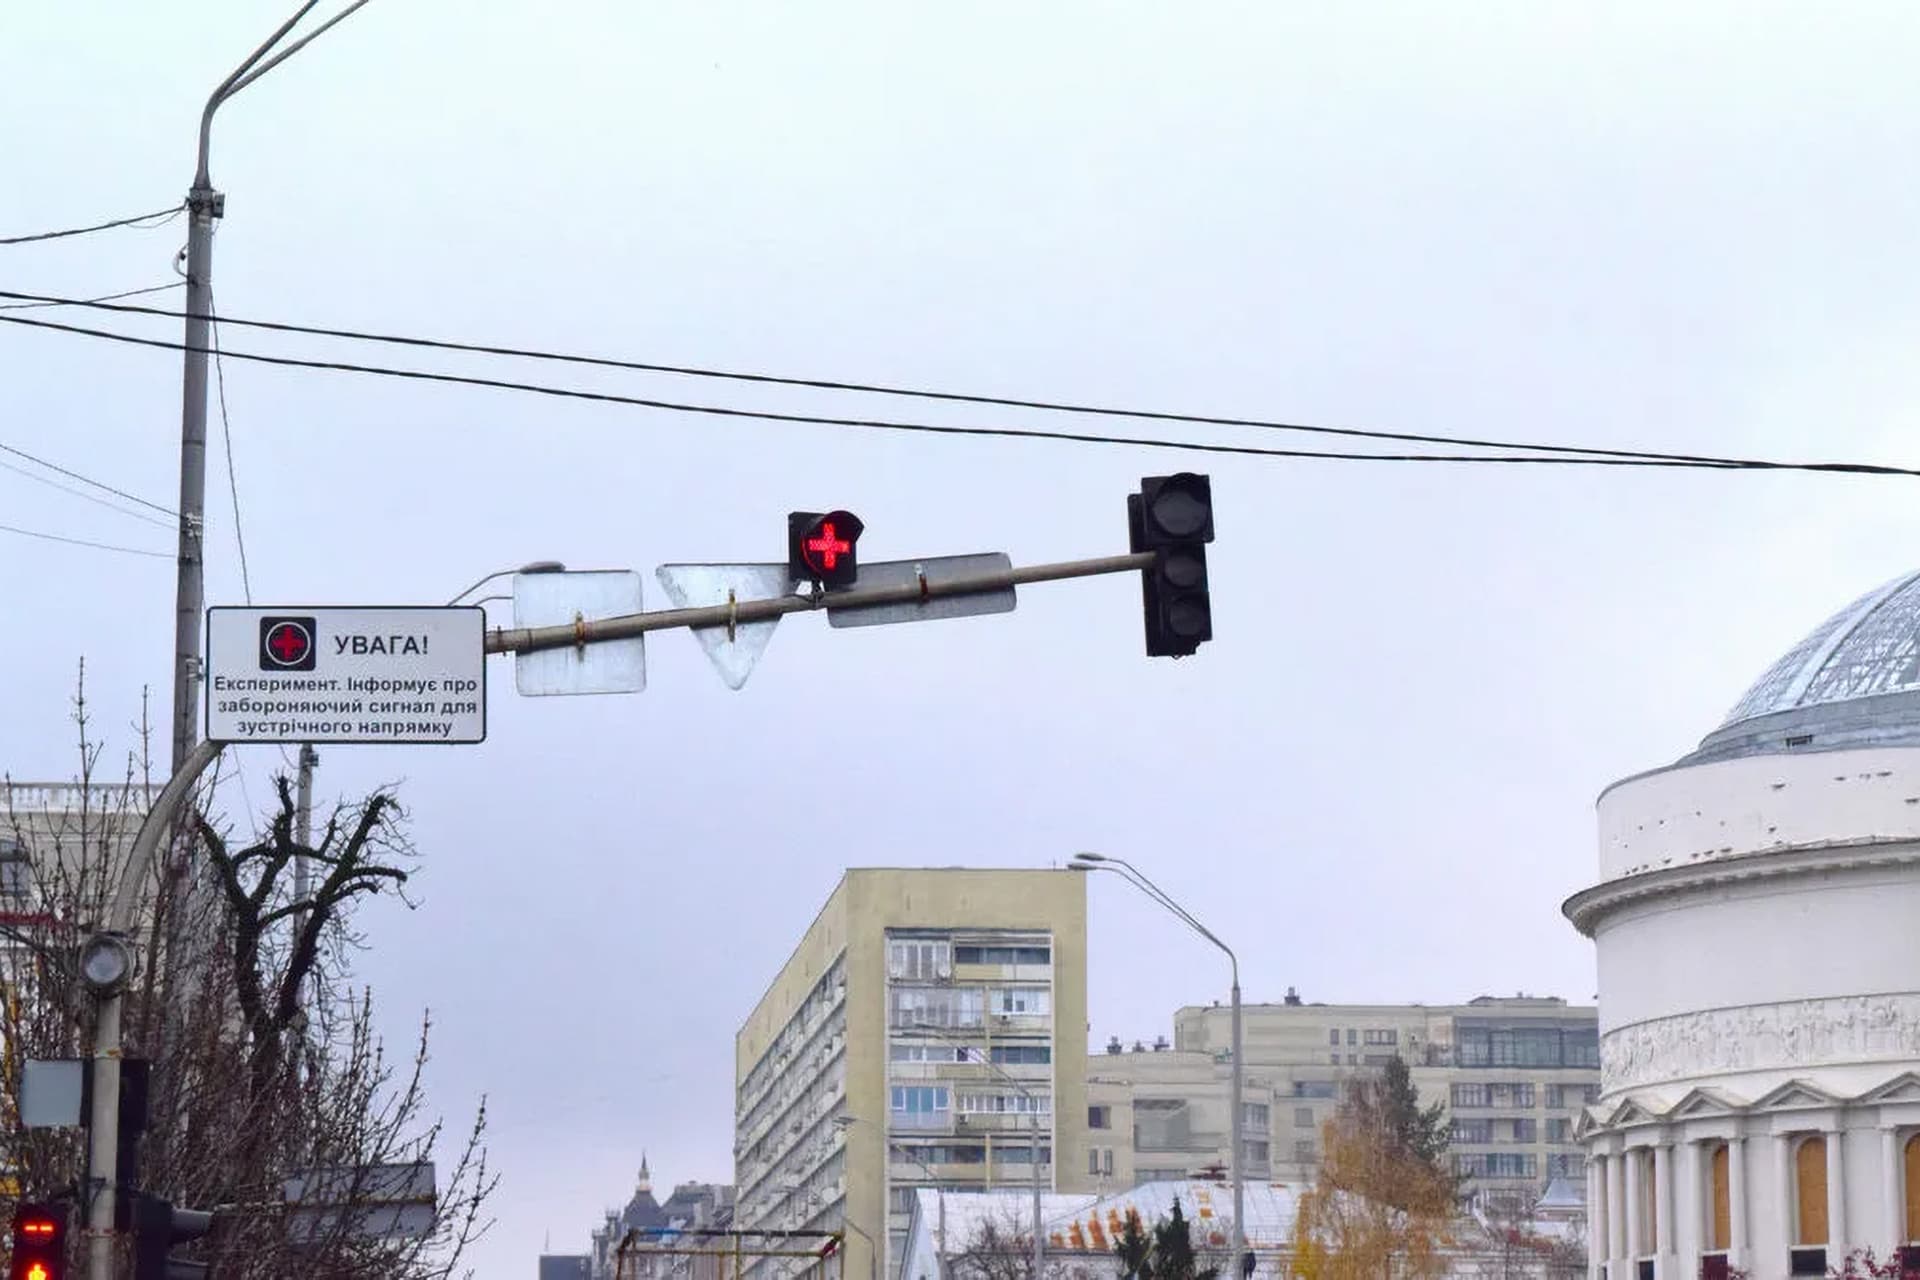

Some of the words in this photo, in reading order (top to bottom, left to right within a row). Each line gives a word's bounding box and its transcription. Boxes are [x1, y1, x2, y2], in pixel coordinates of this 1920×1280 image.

[334, 635, 428, 655] УВАГА!
[214, 675, 341, 692] Експеримент.
[347, 676, 437, 695] Інформує
[443, 678, 477, 694] про
[218, 698, 363, 717] забороняючий
[368, 700, 436, 715] сигнал
[440, 700, 477, 716] для
[237, 719, 352, 737] зустрічного
[357, 720, 453, 737] напрямку
